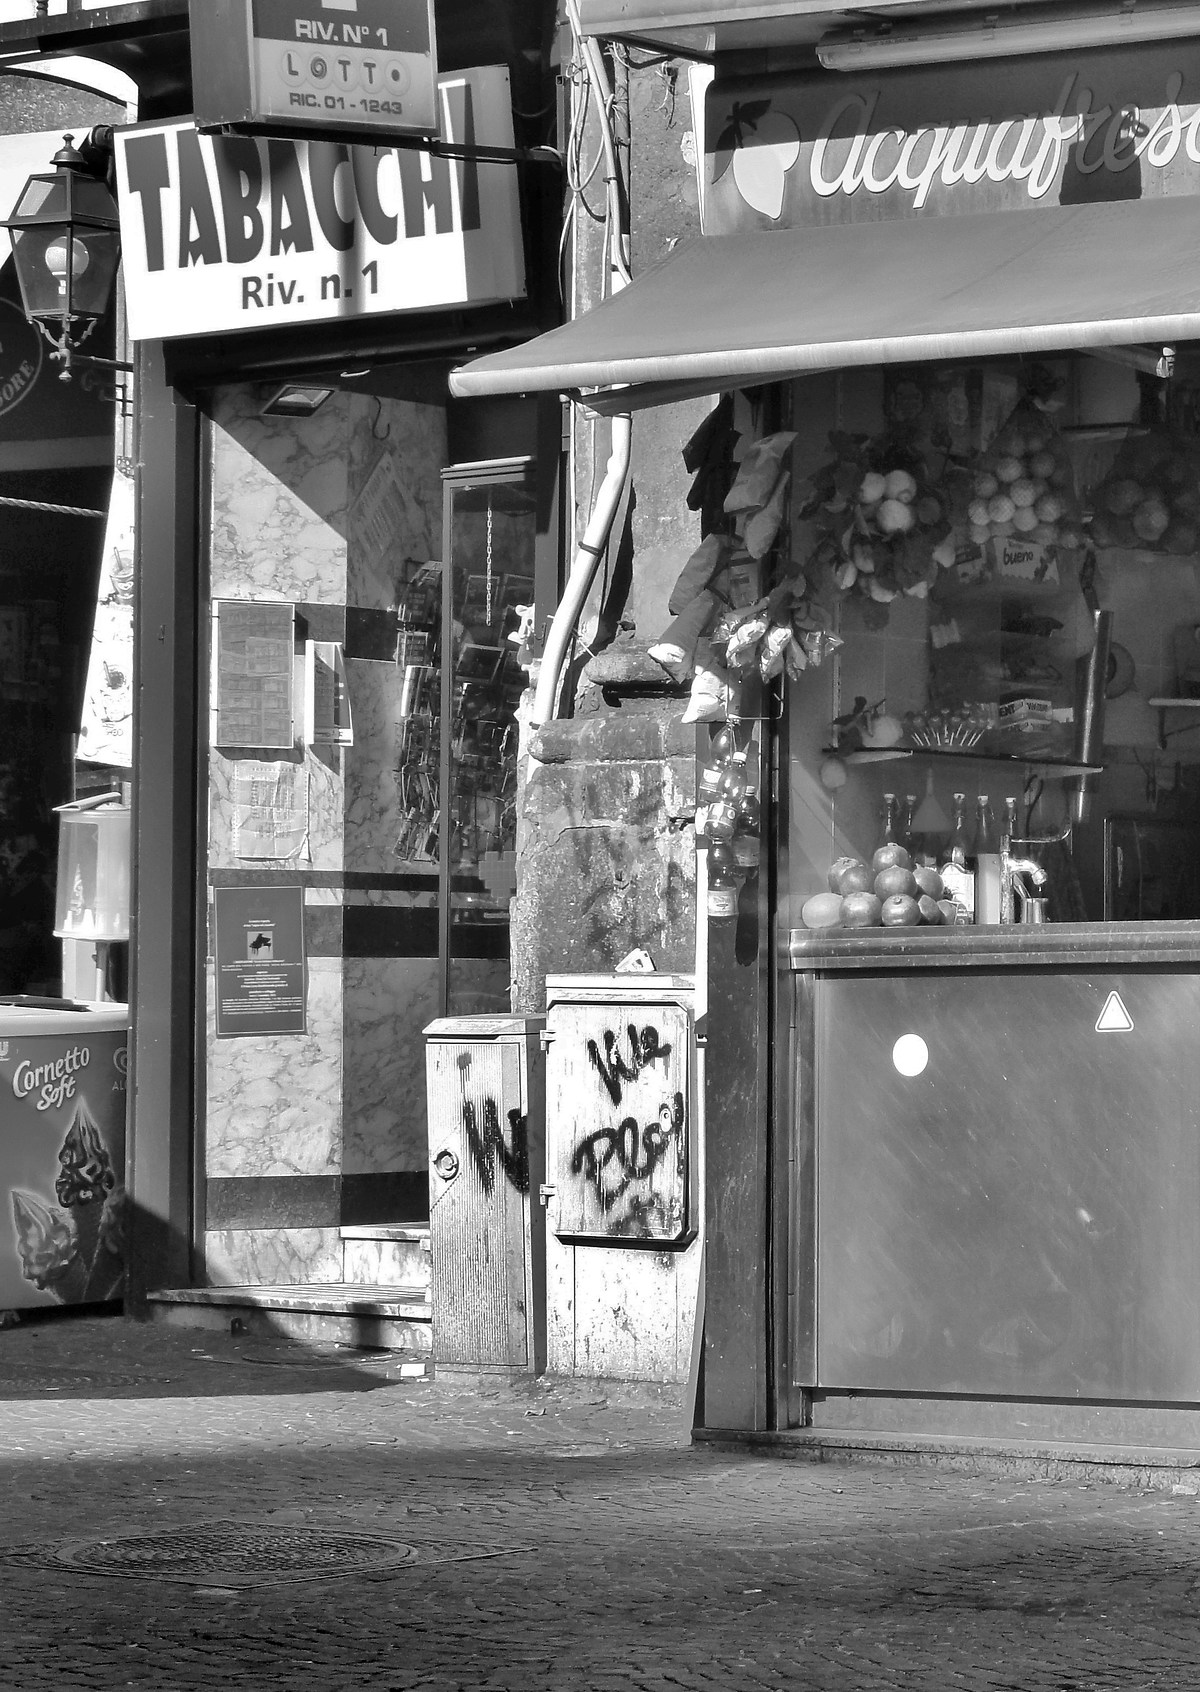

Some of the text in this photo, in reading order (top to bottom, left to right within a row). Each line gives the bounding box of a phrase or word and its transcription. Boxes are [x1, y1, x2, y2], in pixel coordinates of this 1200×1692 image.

[295, 19, 339, 41] RIV.
[376, 28, 388, 46] 1
[285, 52, 402, 85] LOTTO
[289, 92, 321, 108] RIC.
[124, 84, 481, 272] TABACCHI
[242, 260, 378, 309] Riv. n. 1
[13, 1046, 90, 1098] Cornetto
[36, 1074, 76, 1110] Soft
